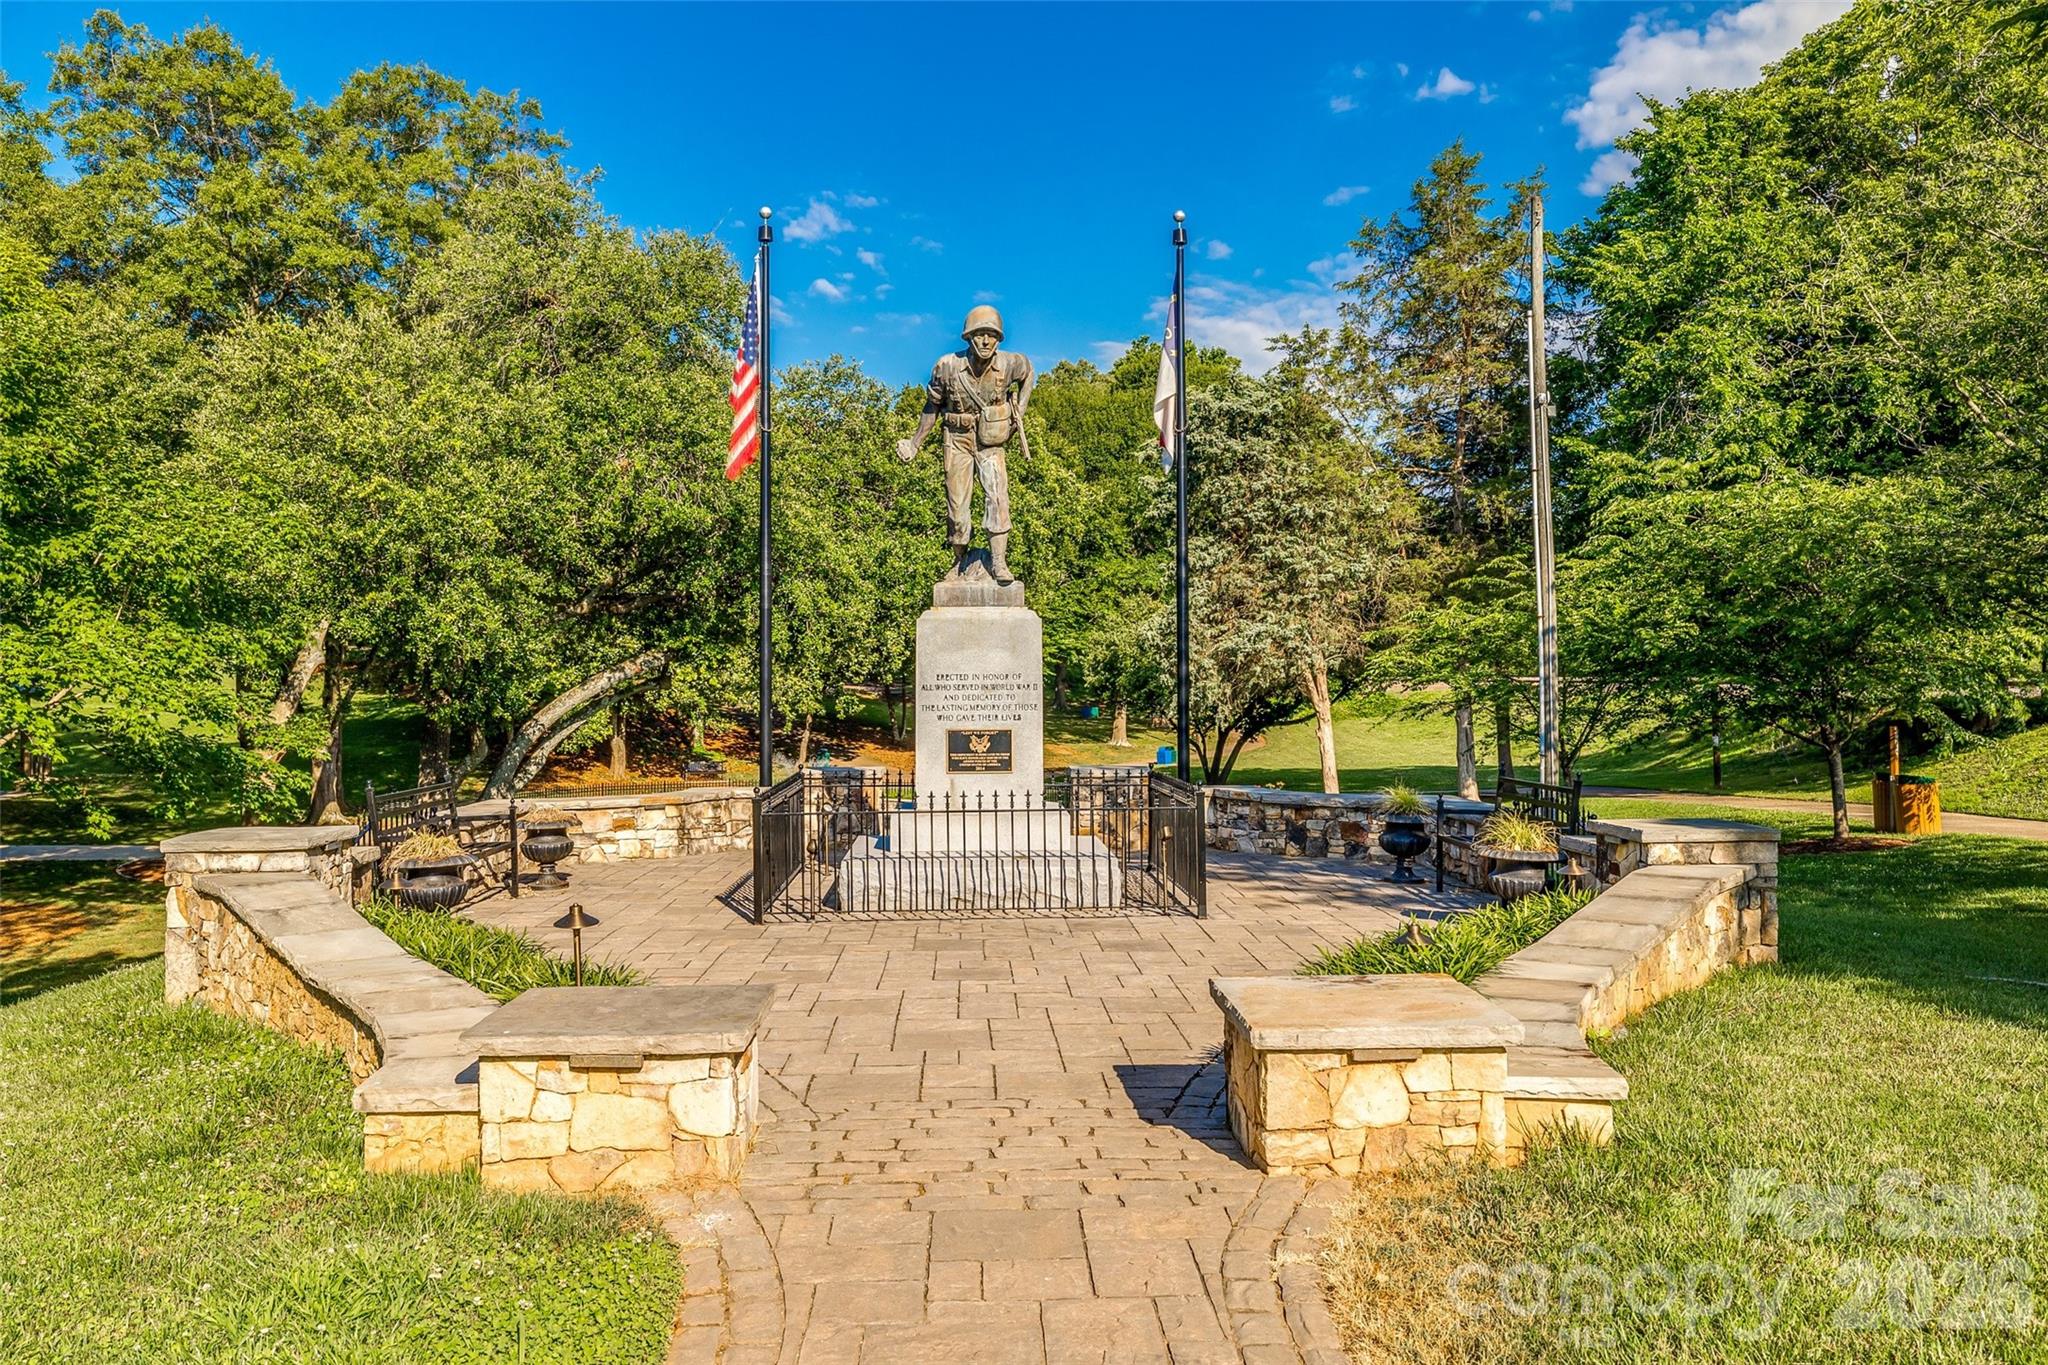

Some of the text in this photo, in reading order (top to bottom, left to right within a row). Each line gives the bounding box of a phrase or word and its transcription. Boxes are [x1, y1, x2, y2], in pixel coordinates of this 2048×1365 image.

[936, 672, 1022, 681] ERECTED IN HONOR OF
[953, 683, 980, 691] SERVED
[981, 683, 989, 691] IN
[990, 683, 1015, 691] WORLD
[1016, 683, 1031, 691] WAR
[1032, 683, 1038, 691] II
[921, 704, 935, 712] THE
[937, 704, 969, 712] LASTING
[1002, 703, 1012, 711] OF
[1014, 703, 1039, 711] THOSE
